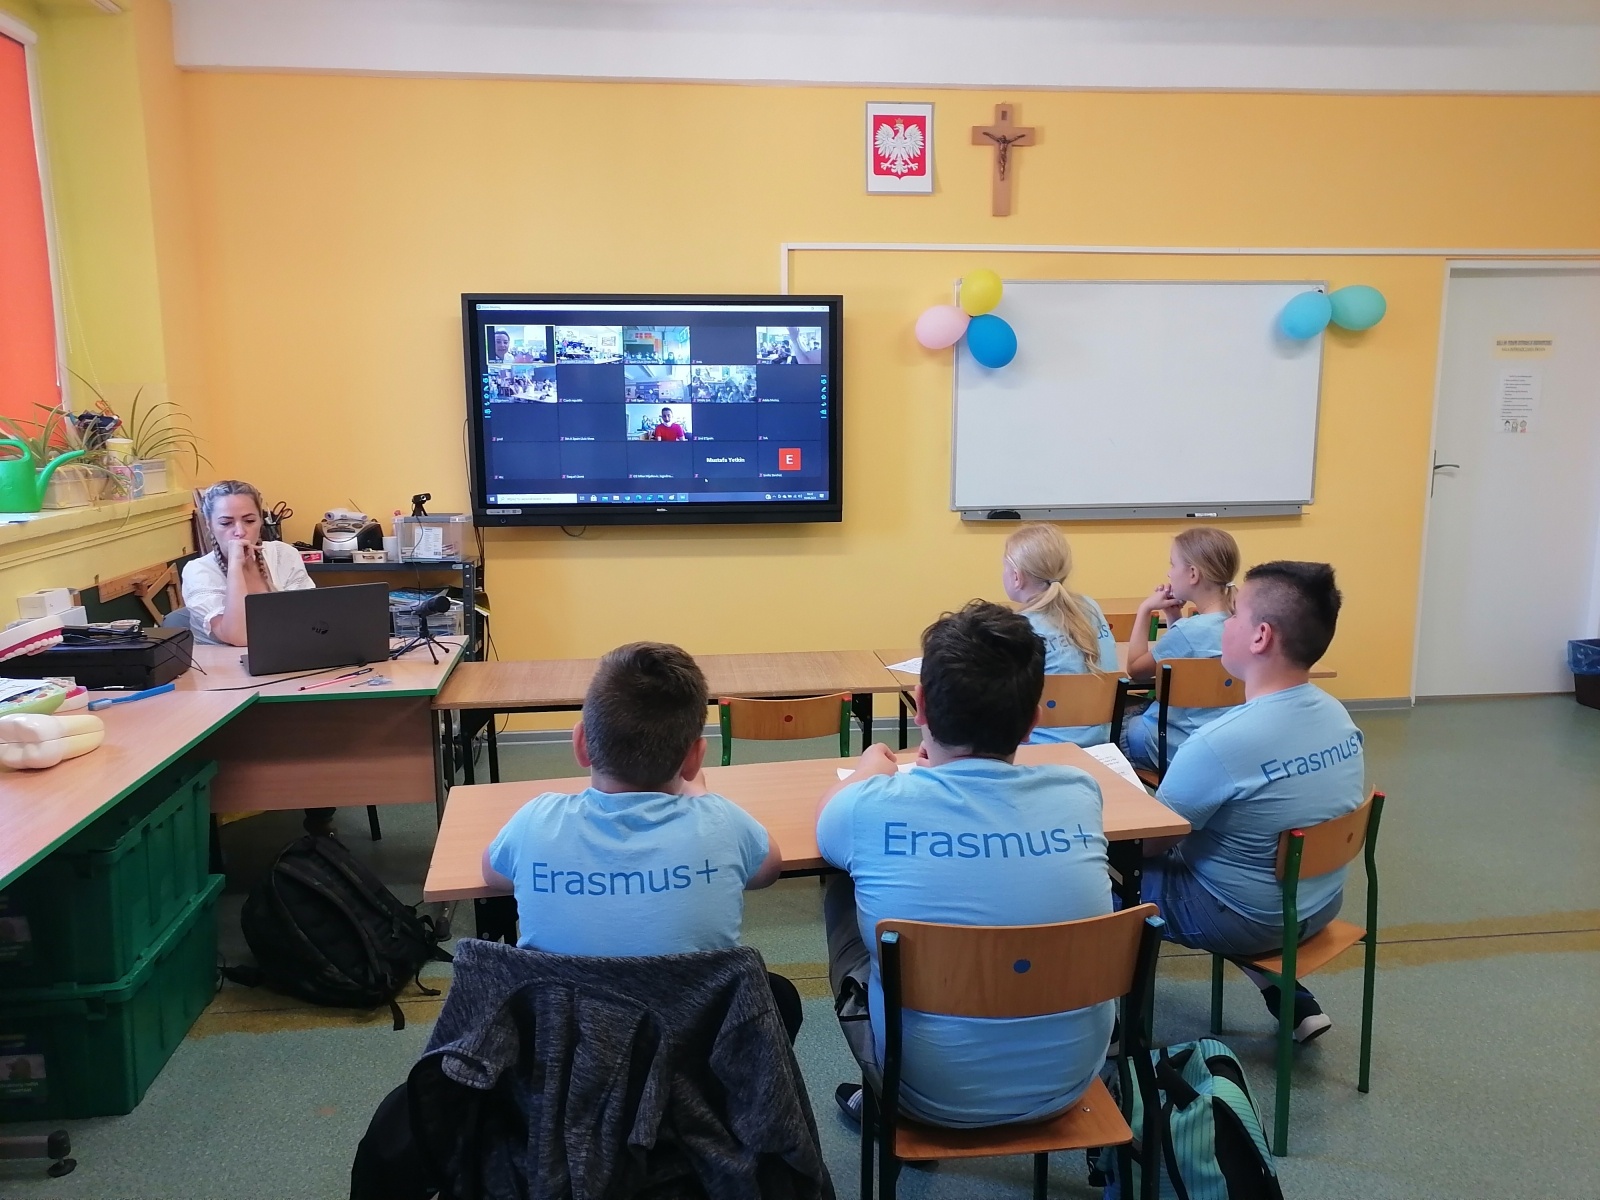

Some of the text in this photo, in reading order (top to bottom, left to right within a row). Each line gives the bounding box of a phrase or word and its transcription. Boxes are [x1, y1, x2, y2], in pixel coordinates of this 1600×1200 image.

[786, 454, 794, 465] E
[884, 821, 1094, 859] Erasmus+
[532, 858, 719, 896] Erasmus+
